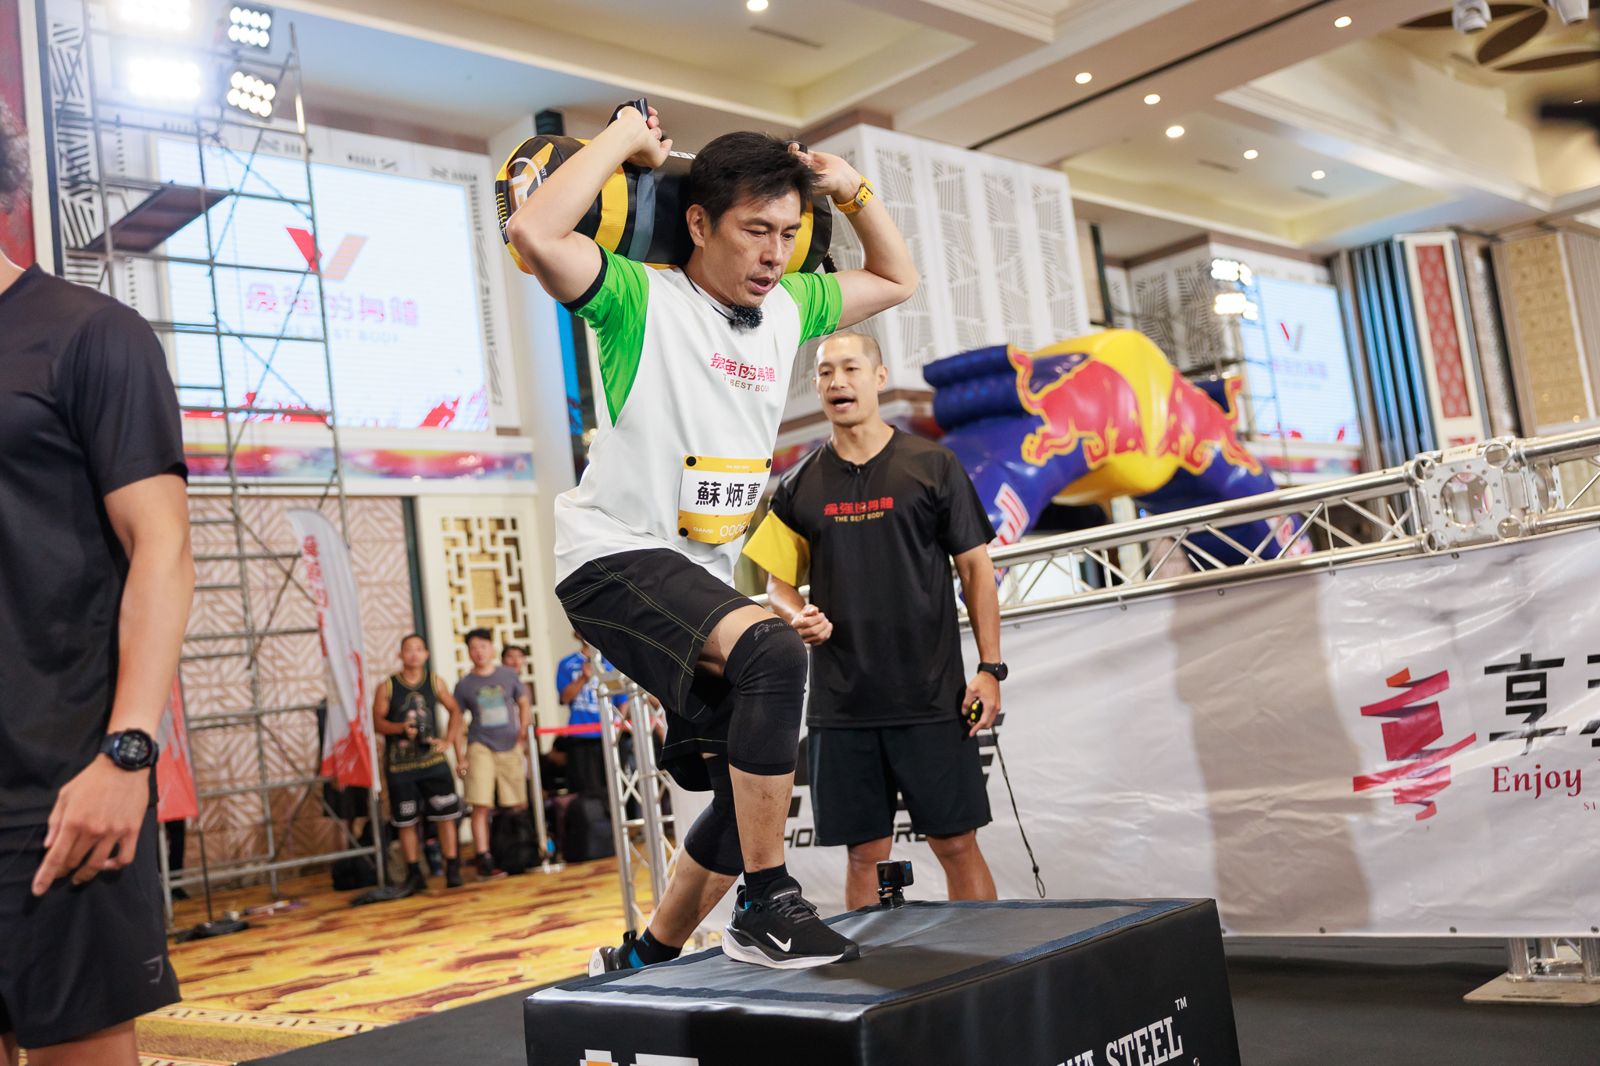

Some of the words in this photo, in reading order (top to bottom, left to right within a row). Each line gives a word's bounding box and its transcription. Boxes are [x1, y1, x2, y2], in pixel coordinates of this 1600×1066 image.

[834, 515, 848, 523] THE
[867, 511, 884, 520] BODY
[1484, 653, 1600, 756] 享
[1492, 764, 1582, 799] Enjoy
[1105, 1016, 1184, 1066] STEEL
